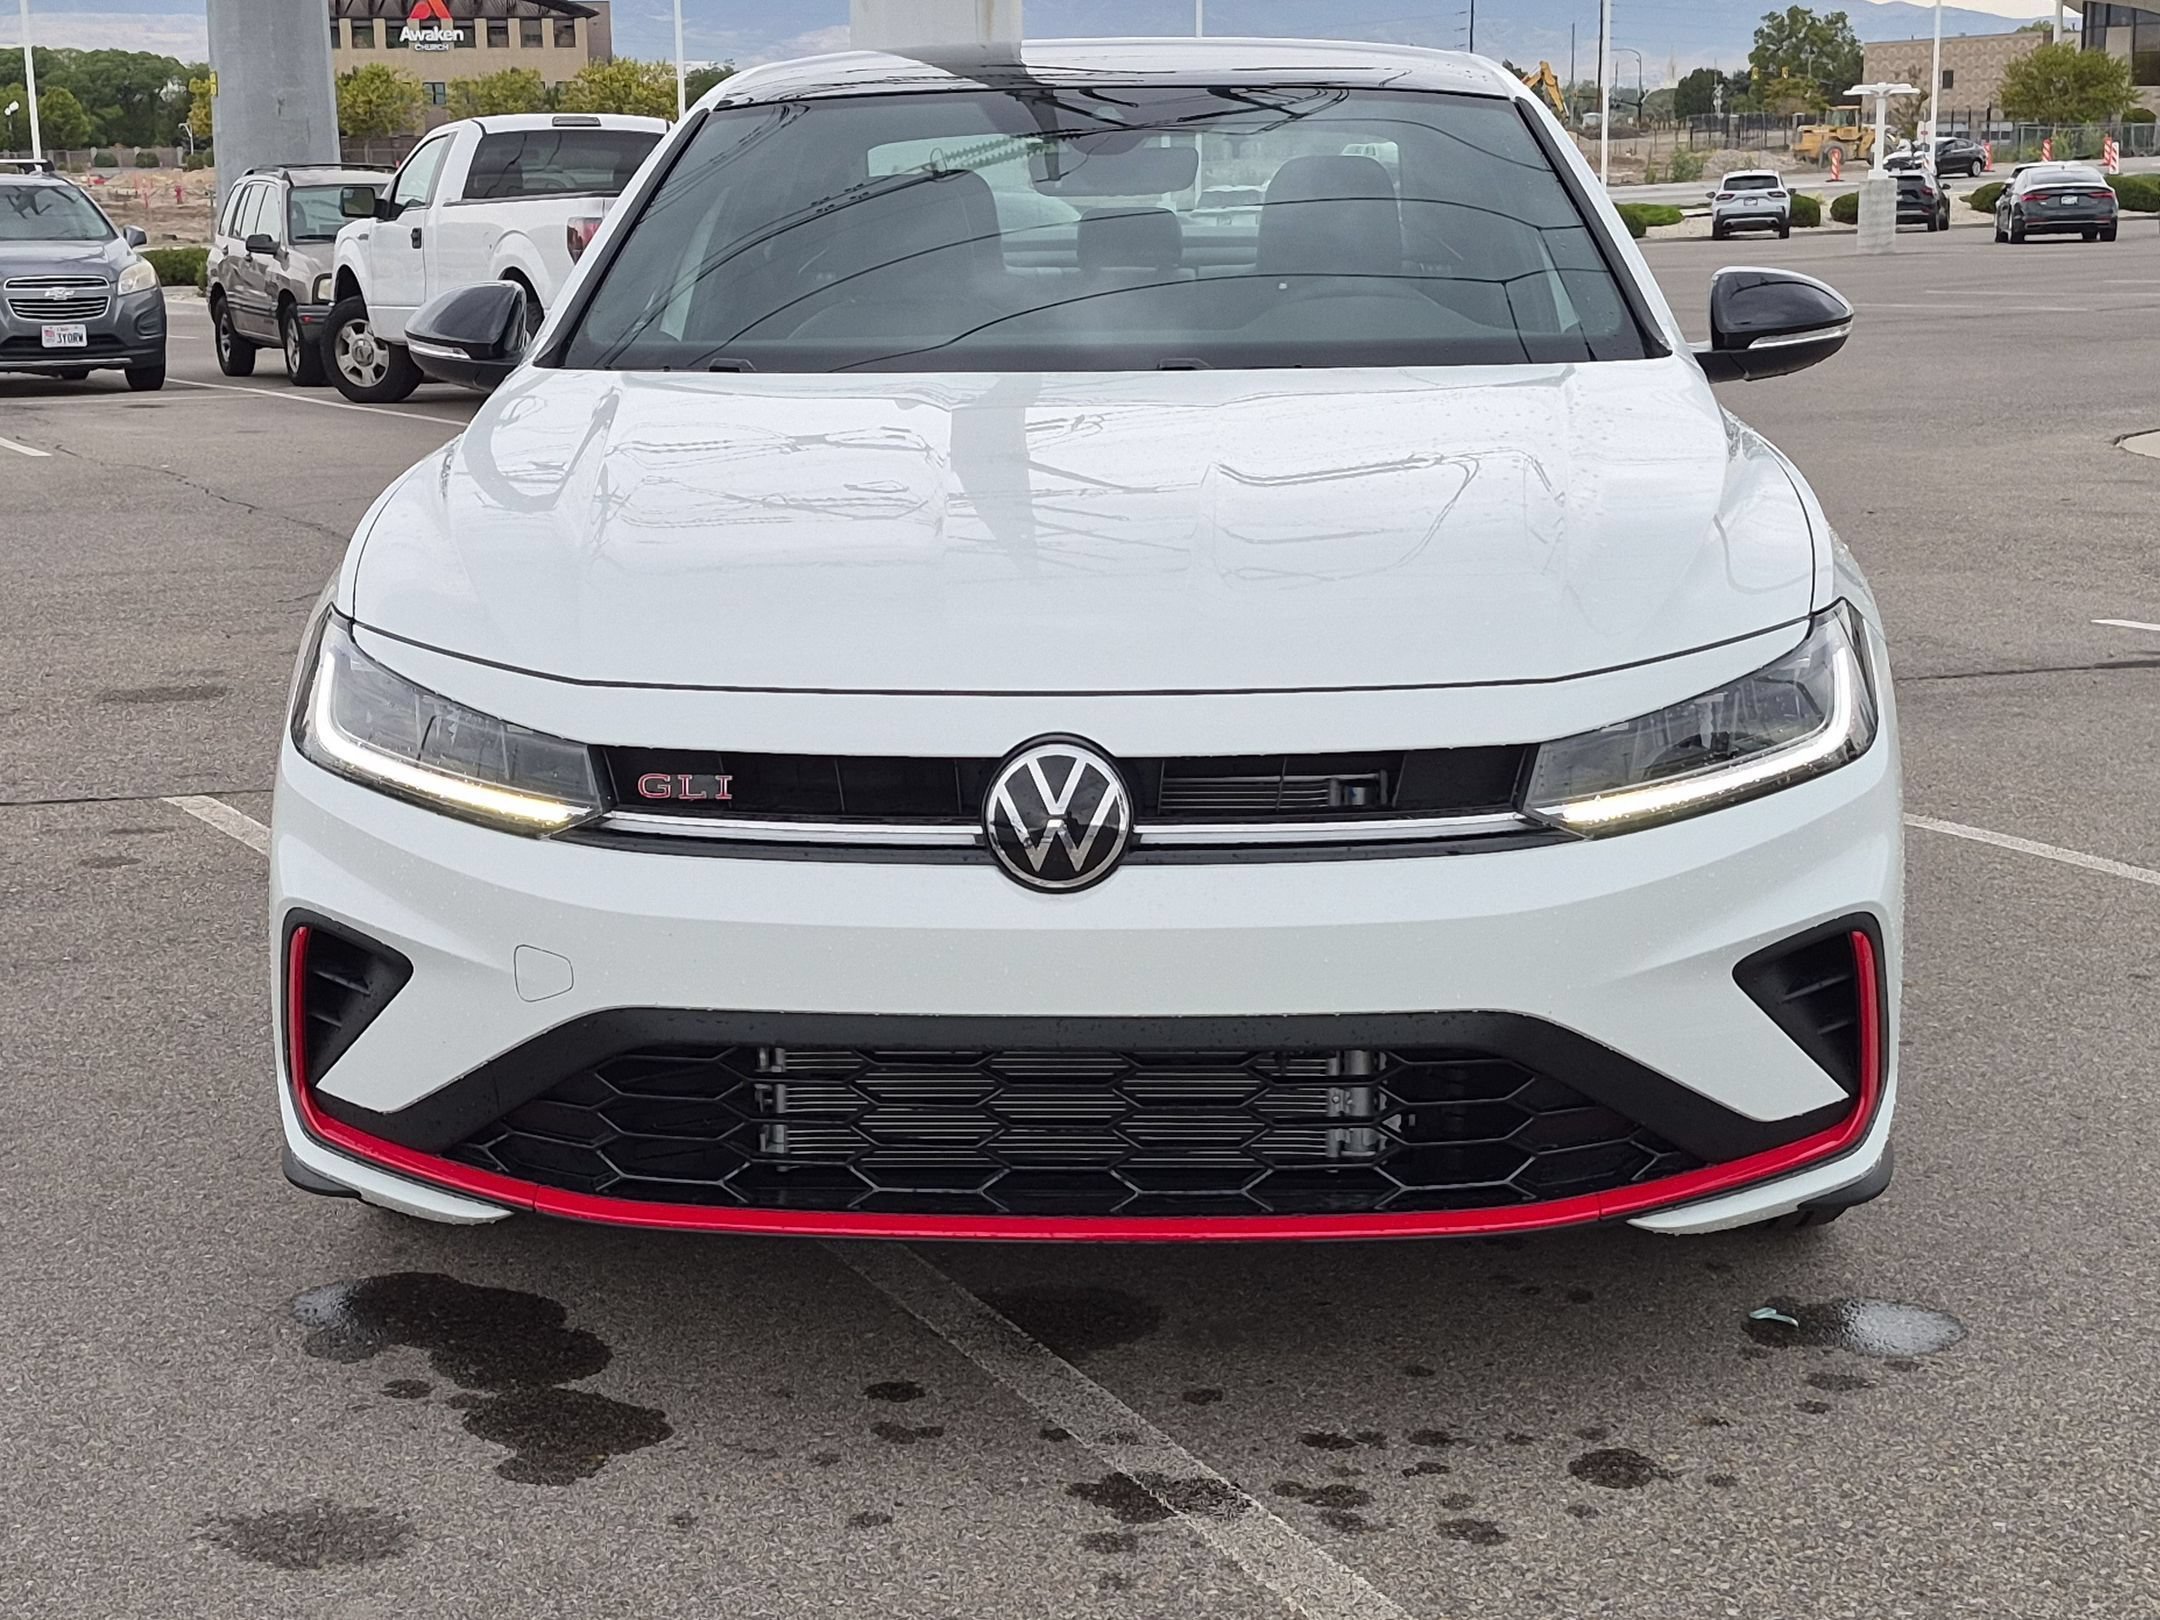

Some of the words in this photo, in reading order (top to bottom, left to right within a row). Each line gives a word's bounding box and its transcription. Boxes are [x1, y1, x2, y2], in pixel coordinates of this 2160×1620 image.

[399, 25, 464, 42] Awaken
[414, 43, 449, 51] CHURCH
[637, 772, 733, 800] GLI
